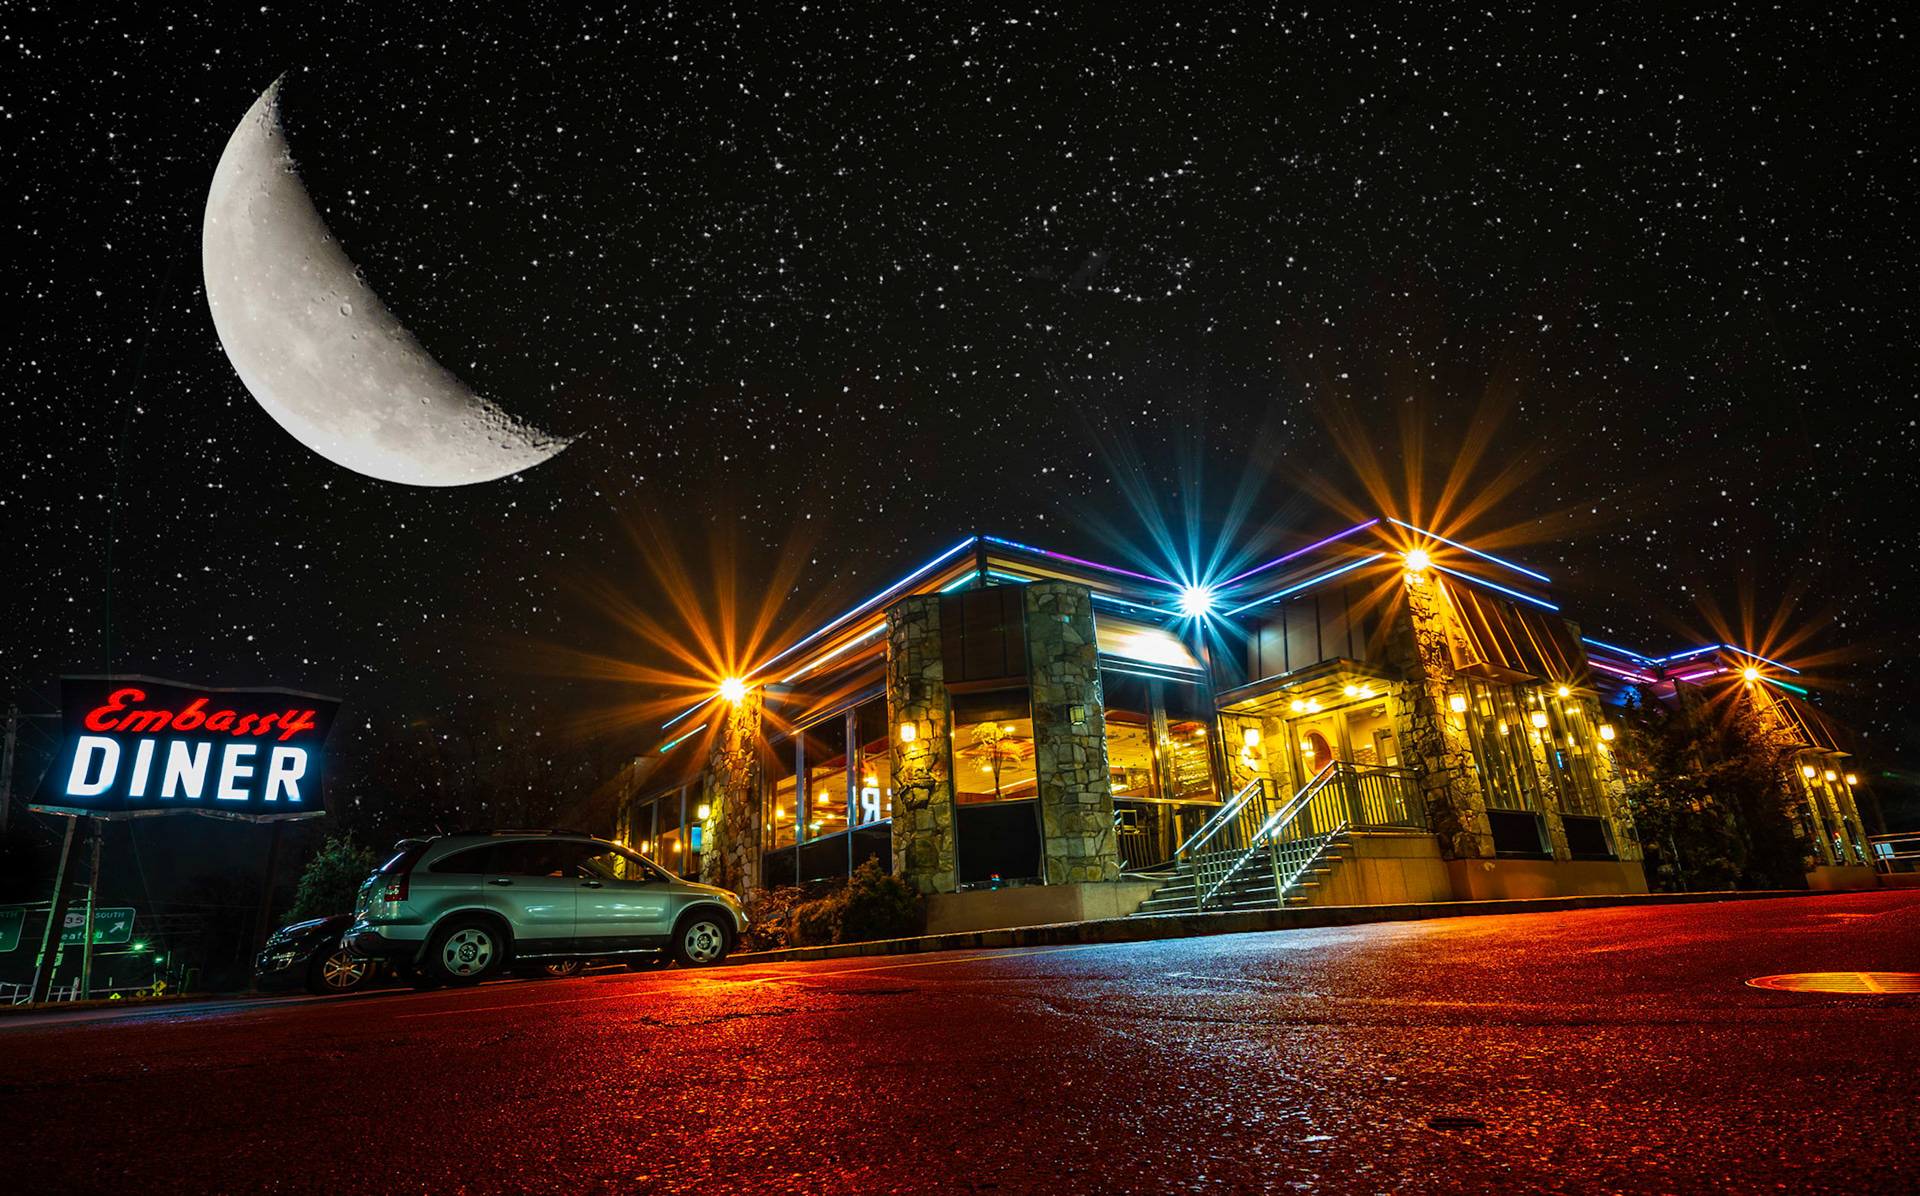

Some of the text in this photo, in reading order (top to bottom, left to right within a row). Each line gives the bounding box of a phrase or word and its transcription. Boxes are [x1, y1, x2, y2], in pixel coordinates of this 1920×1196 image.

[85, 688, 316, 741] Embassy
[66, 736, 308, 802] DINER
[65, 916, 84, 924] 35
[95, 911, 125, 919] SOUTH
